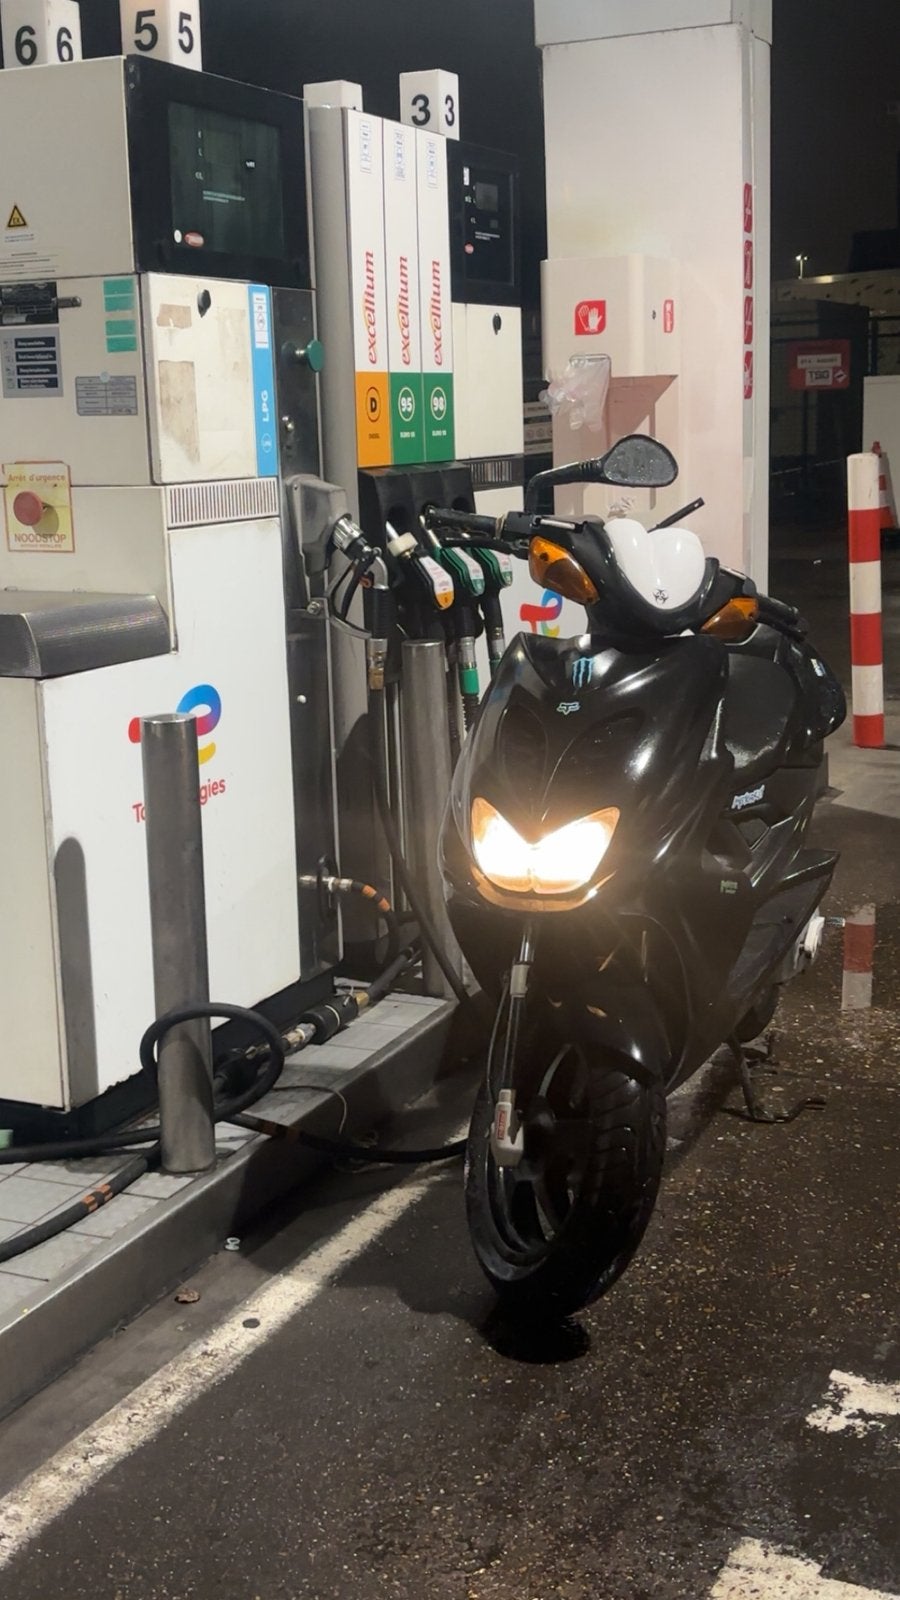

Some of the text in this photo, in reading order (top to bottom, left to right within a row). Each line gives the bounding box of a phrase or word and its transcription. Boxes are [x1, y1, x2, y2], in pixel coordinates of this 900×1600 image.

[15, 25, 38, 65] 6
[56, 27, 74, 62] 6
[133, 9, 159, 52] 5
[178, 12, 194, 54] 5
[411, 93, 431, 126] 3
[444, 94, 455, 127] 3
[364, 250, 377, 365] excellium
[398, 255, 411, 366] excellium
[430, 260, 443, 366] excellium
[260, 390, 270, 422] LPG
[370, 398, 377, 412] D
[400, 396, 413, 412] 95
[432, 396, 445, 412] 98
[8, 473, 66, 483] Arrêt d'urgence
[14, 532, 66, 543] NOODSTOP
